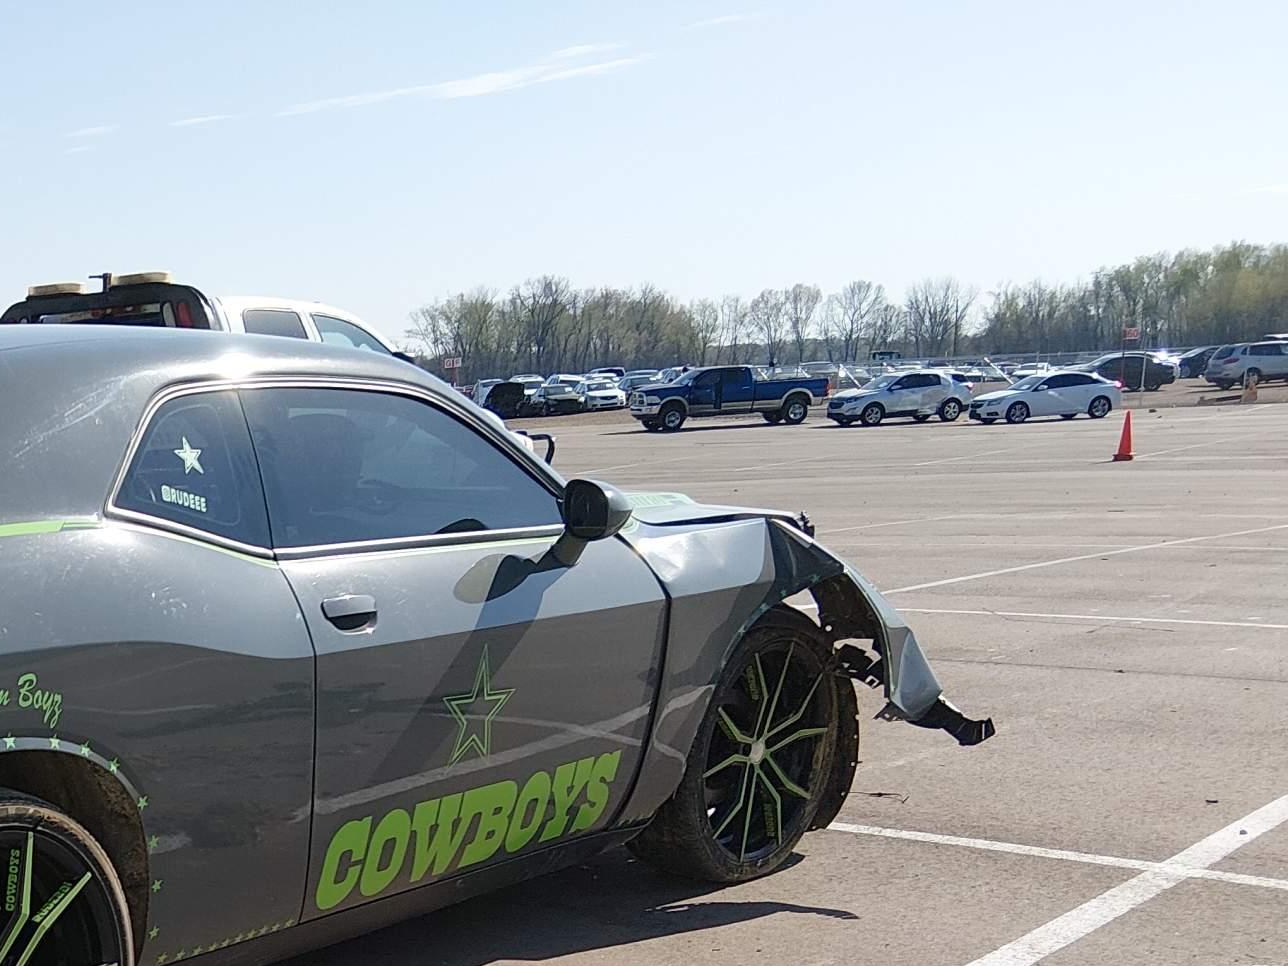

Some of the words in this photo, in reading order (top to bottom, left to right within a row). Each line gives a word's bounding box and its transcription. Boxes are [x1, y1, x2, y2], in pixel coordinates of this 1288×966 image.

[17, 672, 63, 729] Boyz
[316, 749, 622, 911] COWBOYS
[5, 849, 21, 912] COWBOYS
